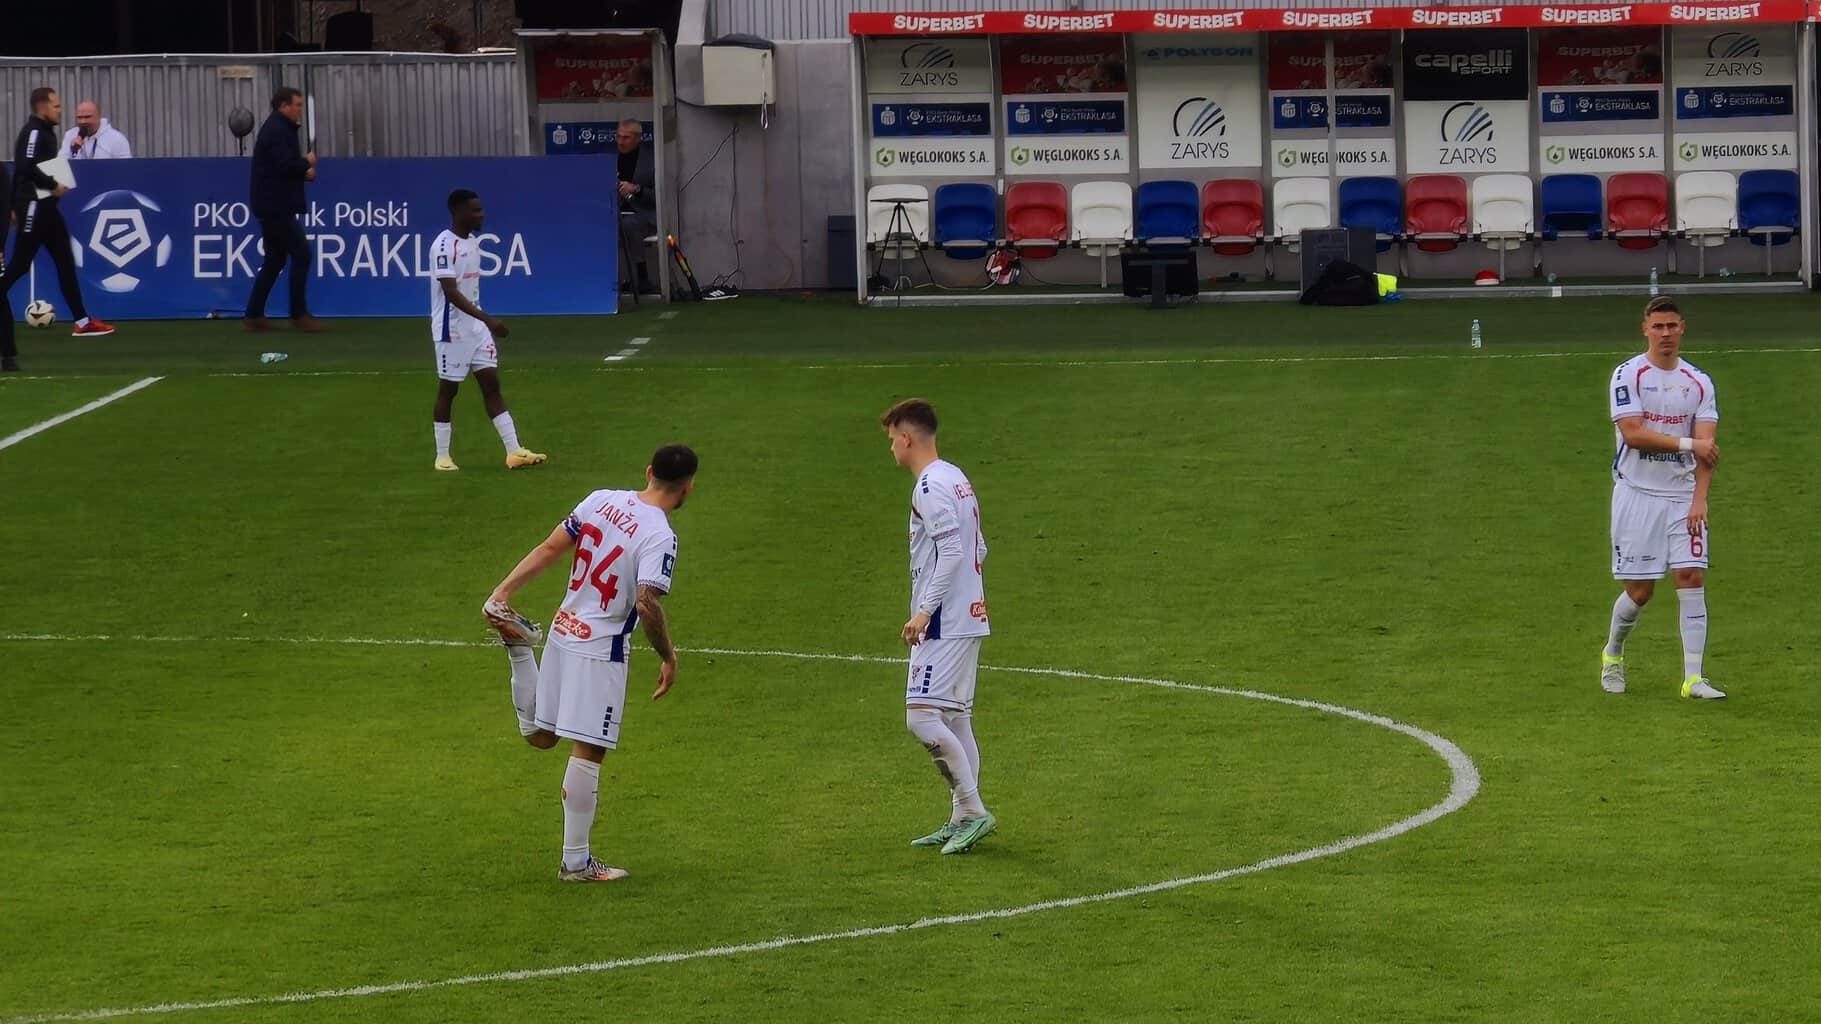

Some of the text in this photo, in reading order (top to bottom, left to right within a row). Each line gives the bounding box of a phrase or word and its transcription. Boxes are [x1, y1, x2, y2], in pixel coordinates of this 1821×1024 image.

[1154, 11, 1244, 29] SUPERBET
[1283, 10, 1374, 28] SUPERBET
[1412, 8, 1503, 26] SUPERBET
[1542, 6, 1632, 24] SUPERBET
[1670, 3, 1760, 21] SUPERBET
[894, 14, 985, 31] SUPERBET
[1024, 13, 1115, 31] SUPERBET
[1558, 44, 1643, 57] SUPERBET
[1020, 53, 1105, 65] SUPERBET
[1415, 49, 1512, 72] capelli
[1461, 67, 1512, 75] SPORT
[1705, 62, 1763, 77] ZARYS
[900, 72, 958, 87] ZARYS
[1595, 101, 1651, 111] EKSTRAKLASA
[1729, 96, 1784, 106] EKSTRAKLASA
[926, 111, 983, 123] EKSTRAKLASA
[1061, 111, 1117, 121] EKSTRAKLASA
[899, 150, 989, 166] WĘGLOKOKS S.A.
[1034, 149, 1123, 163] WĘGLOKOKS S.A.
[1171, 142, 1230, 160] ZARYS
[1371, 151, 1390, 164] S.A.
[1439, 147, 1497, 164] ZARYS
[1569, 147, 1659, 162] WĘGLOKOKS S.A.
[1702, 144, 1791, 160] WĘGLOKOKS S.A.
[194, 202, 250, 228] PKO
[335, 200, 408, 228] Polski
[1643, 411, 1688, 425] SUPERBET
[595, 501, 641, 539] JANŽA
[1690, 534, 1703, 558] 6
[569, 522, 625, 612] 64
